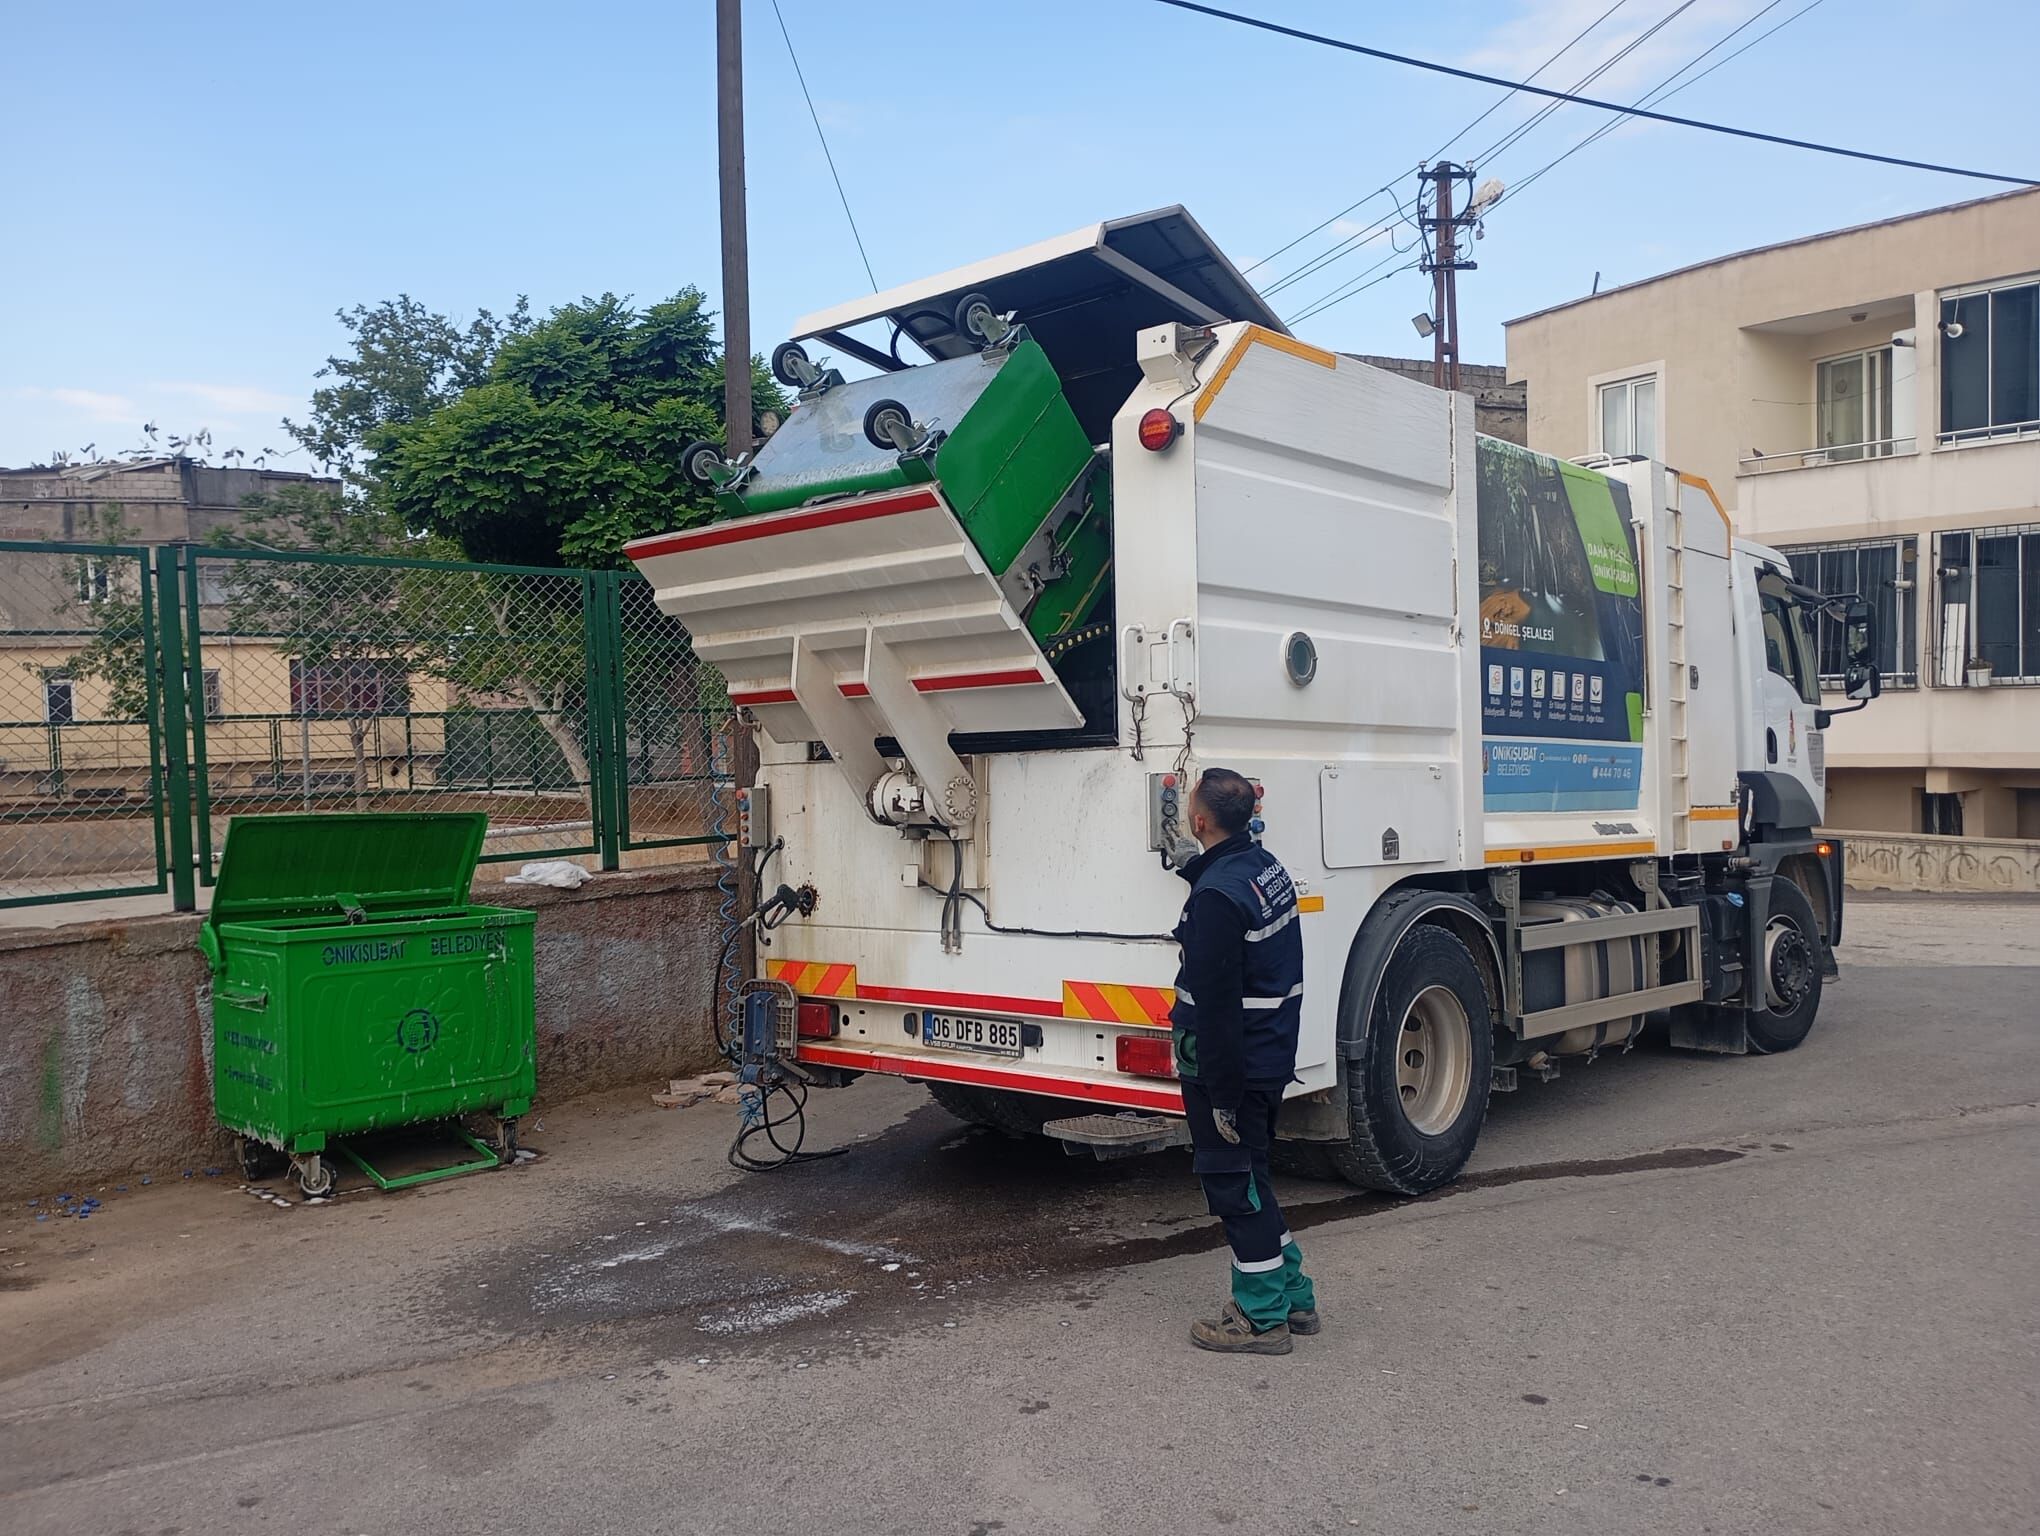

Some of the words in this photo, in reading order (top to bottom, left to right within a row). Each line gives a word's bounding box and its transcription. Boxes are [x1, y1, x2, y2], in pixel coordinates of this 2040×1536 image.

[1587, 543, 1608, 560] DAHA
[1494, 619, 1521, 637] DÖNGEL
[1522, 626, 1555, 641] ŞELALESİ
[1492, 745, 1538, 763] ONİKİŞUBAT
[1599, 768, 1612, 778] 444
[1613, 768, 1622, 778] 70
[933, 1017, 950, 1038] 06
[956, 1020, 982, 1042] DFB
[989, 1023, 1017, 1046] 885
